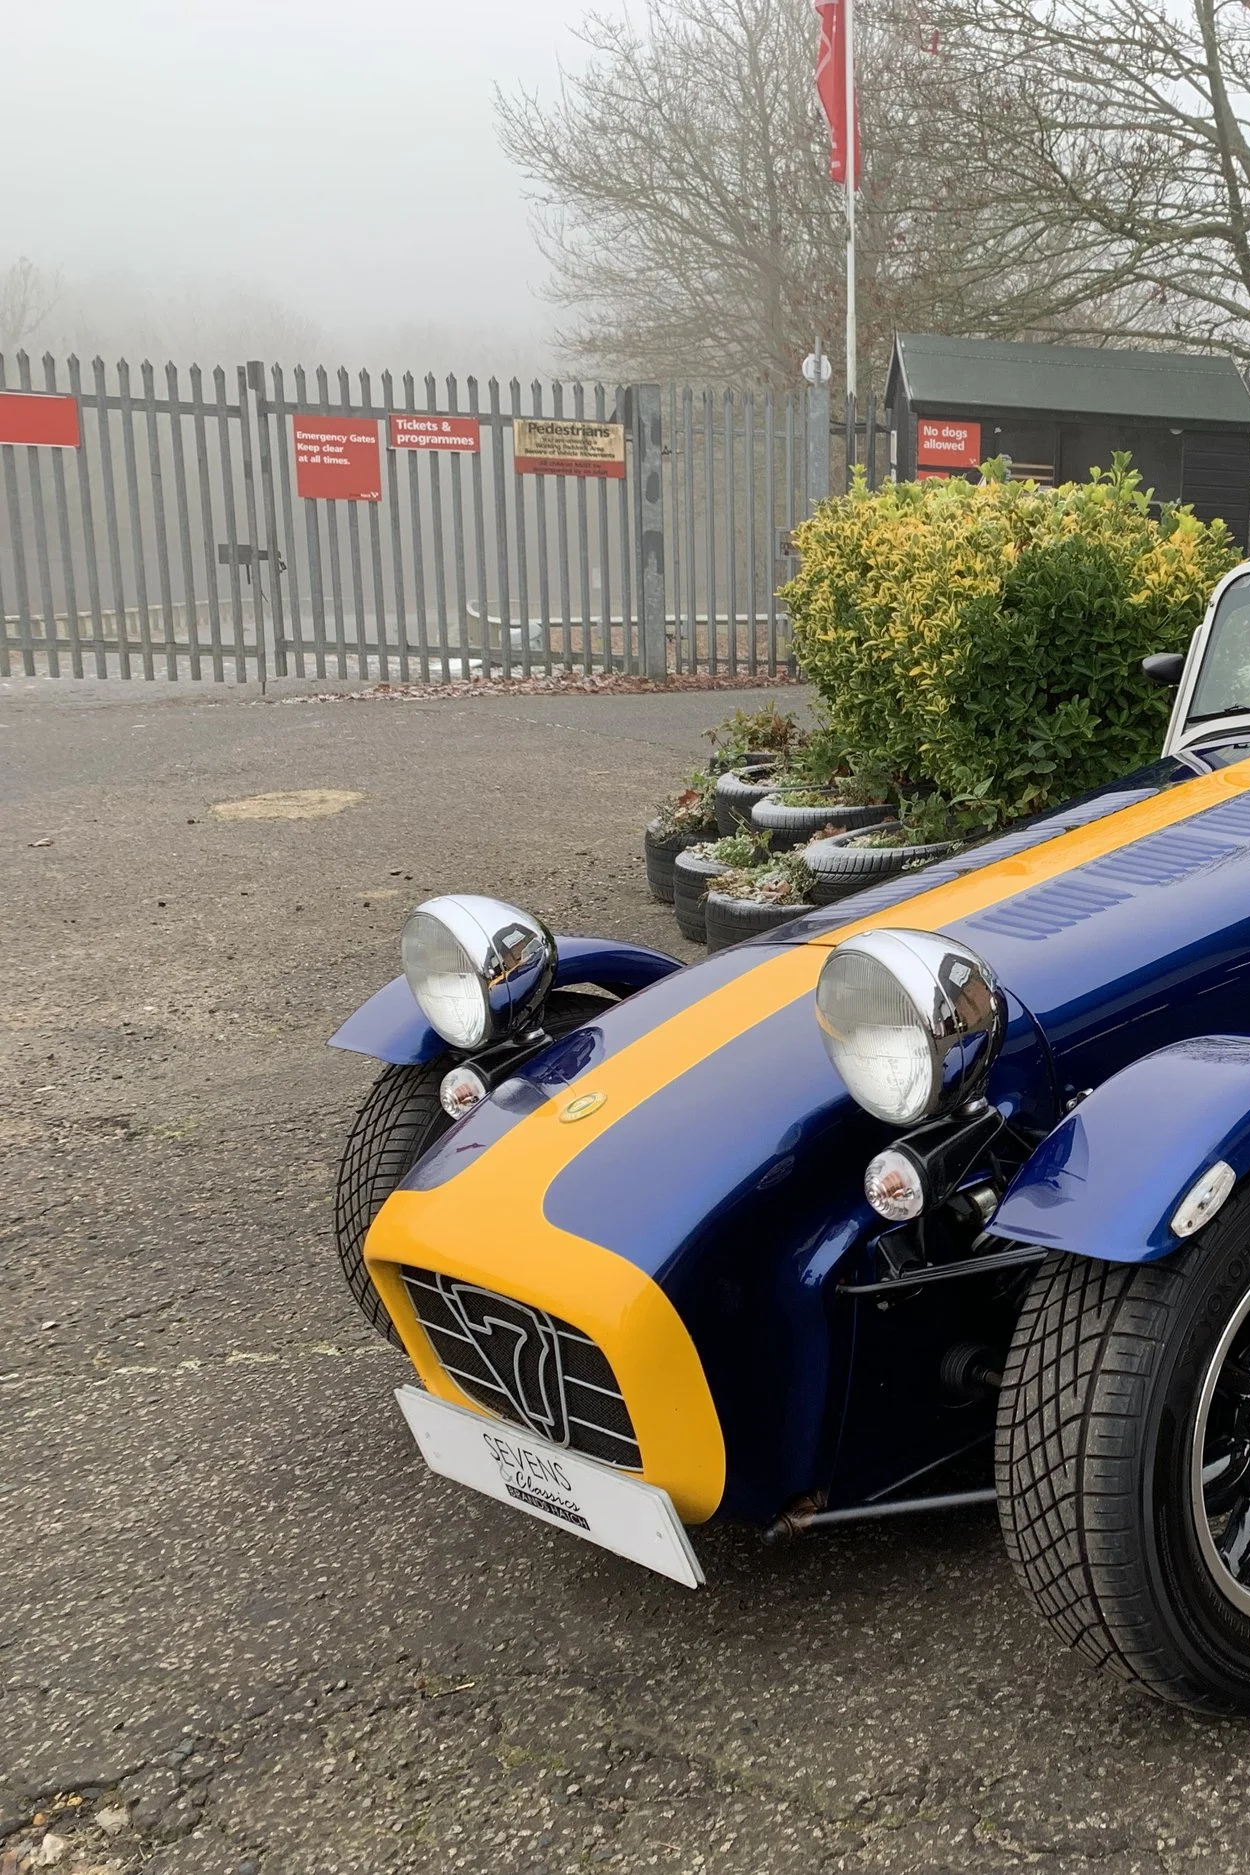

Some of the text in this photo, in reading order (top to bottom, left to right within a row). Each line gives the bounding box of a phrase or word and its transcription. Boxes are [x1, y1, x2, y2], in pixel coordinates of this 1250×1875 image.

[396, 419, 452, 432] Tickets &
[527, 422, 610, 438] Pedestrians
[296, 431, 376, 444] Emergency Gates
[923, 425, 968, 440] No dogs
[396, 433, 475, 446] programmes
[923, 438, 965, 451] allowed
[297, 443, 344, 454] Keep clear
[298, 454, 351, 466] at all times.
[482, 1432, 572, 1491] SEVENS
[515, 1470, 580, 1512] Classics
[508, 1487, 590, 1530] BRANDS HATCH
